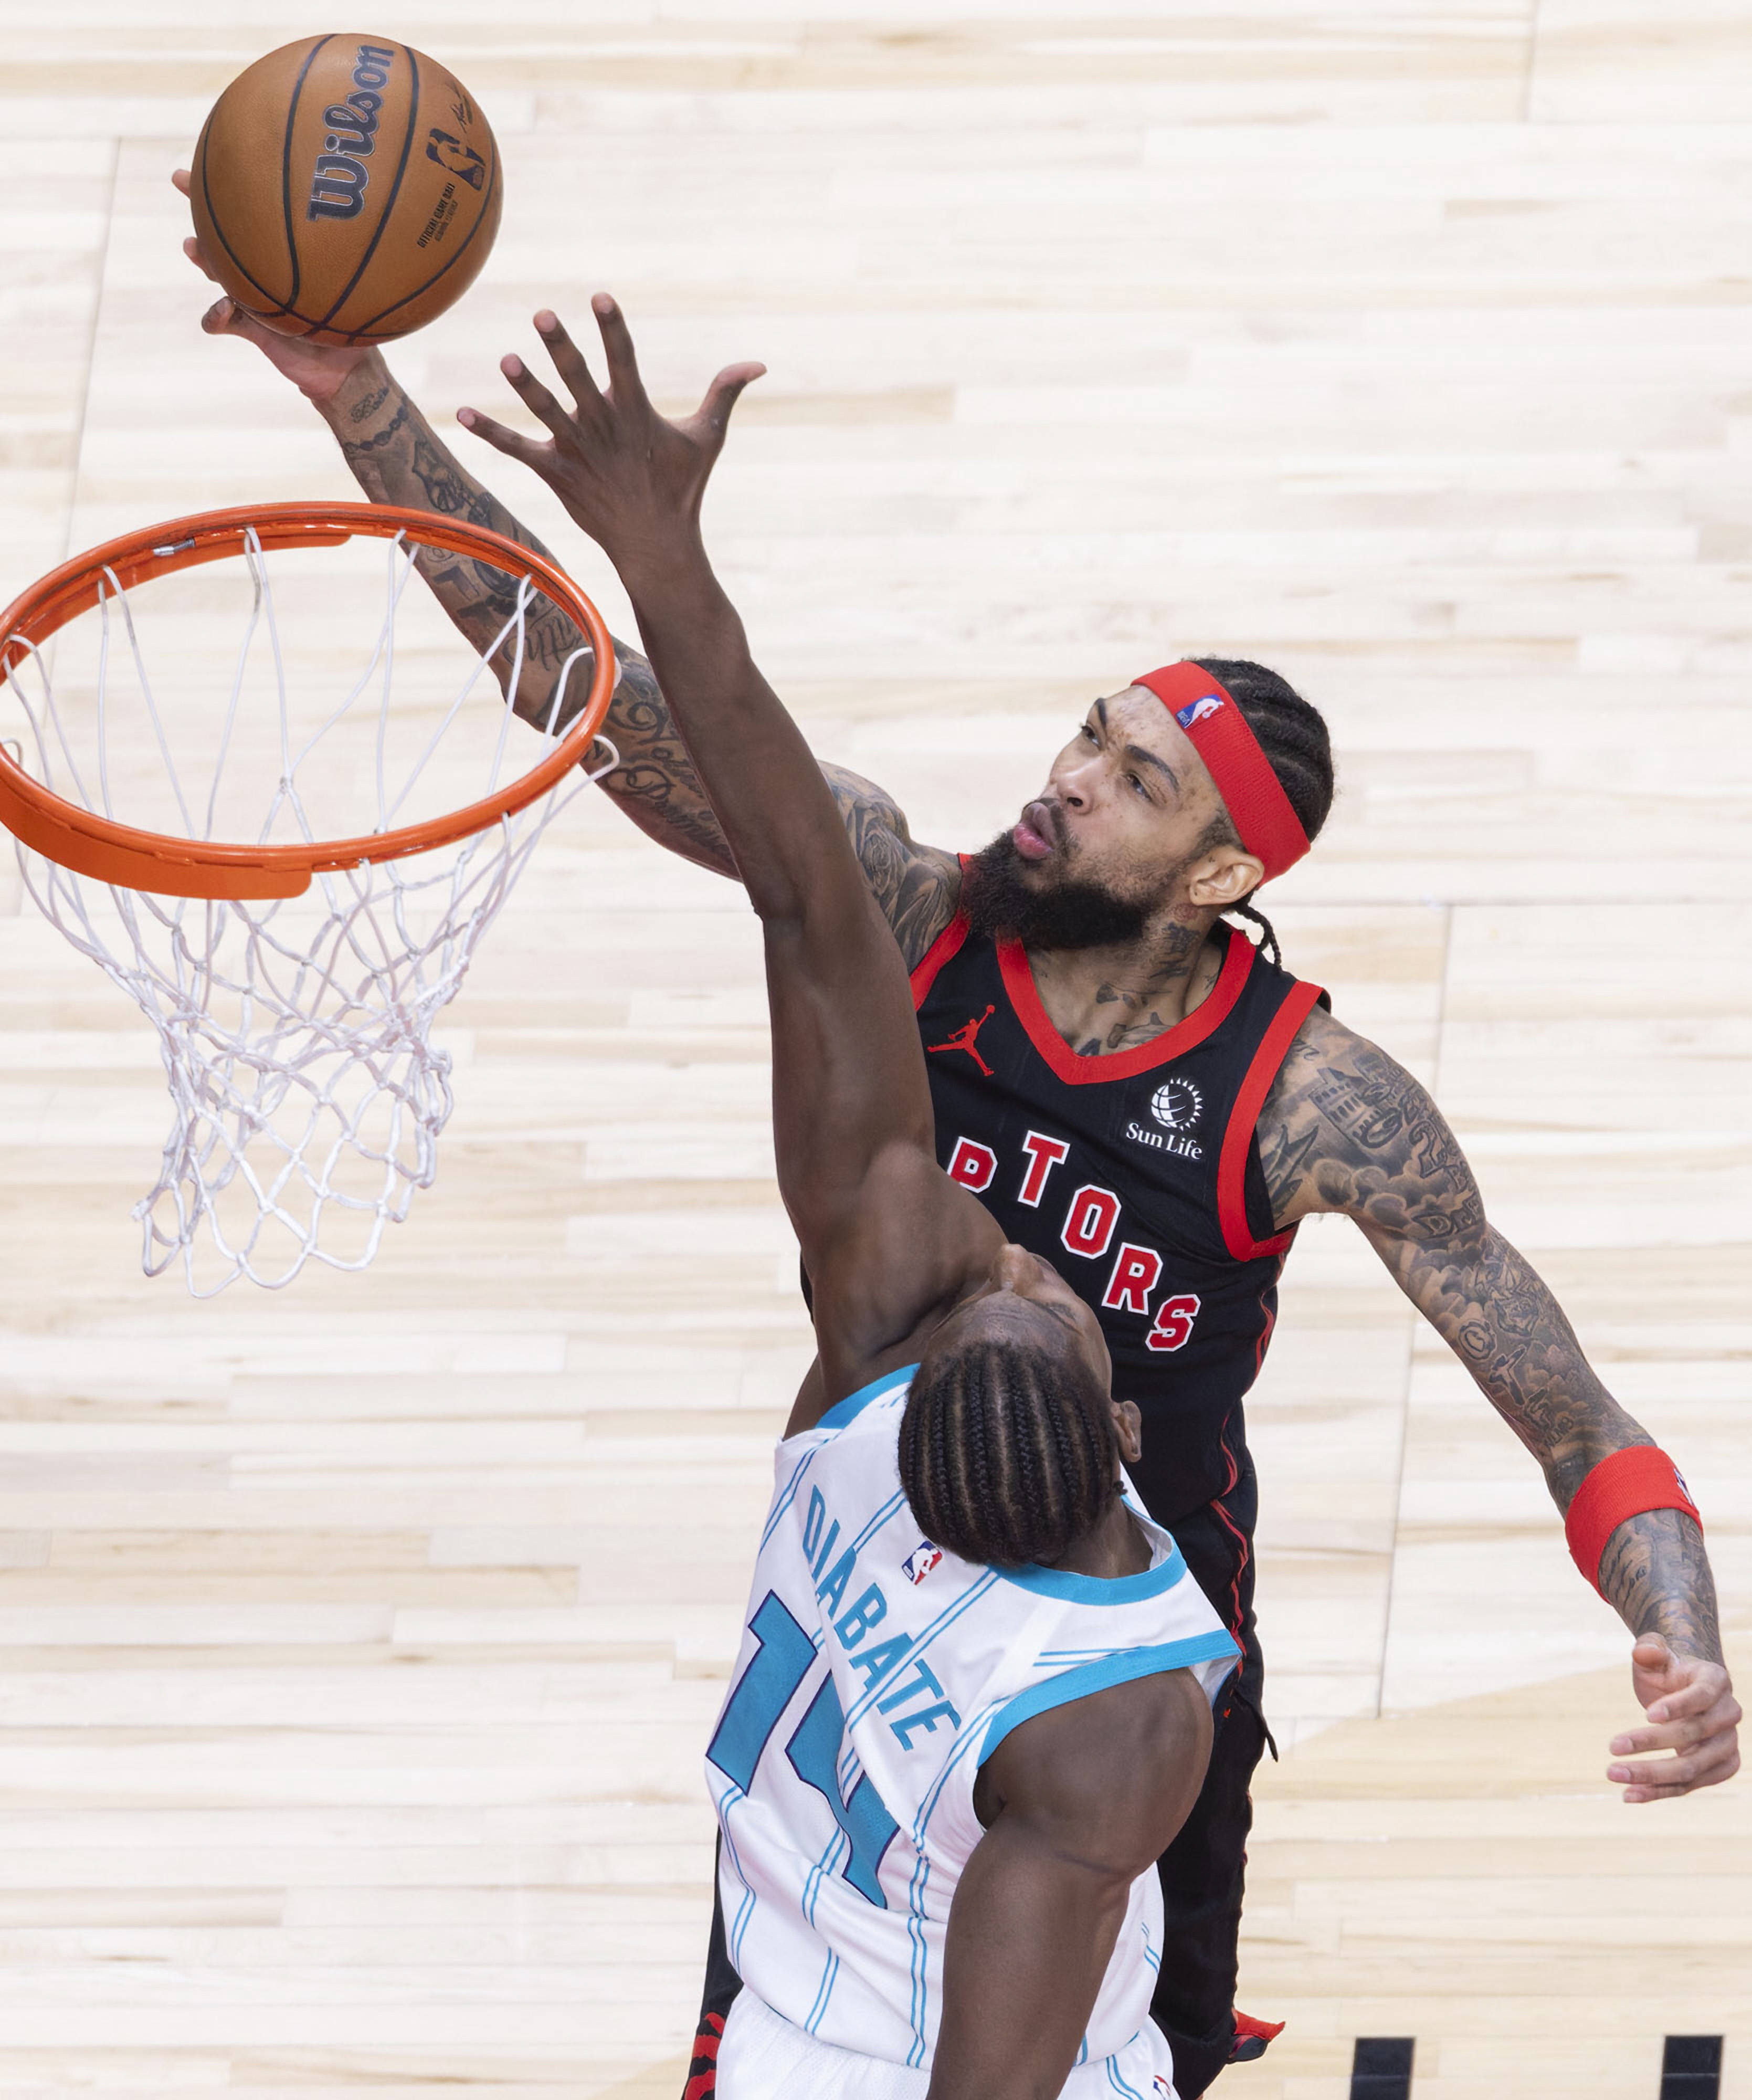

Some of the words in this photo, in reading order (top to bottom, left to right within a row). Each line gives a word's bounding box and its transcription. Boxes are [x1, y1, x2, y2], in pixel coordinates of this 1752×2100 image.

[306, 45, 395, 222] Wilson
[1126, 1122, 1163, 1148] Sun
[1166, 1135, 1202, 1159] Life
[803, 1484, 962, 1751] DIABATE
